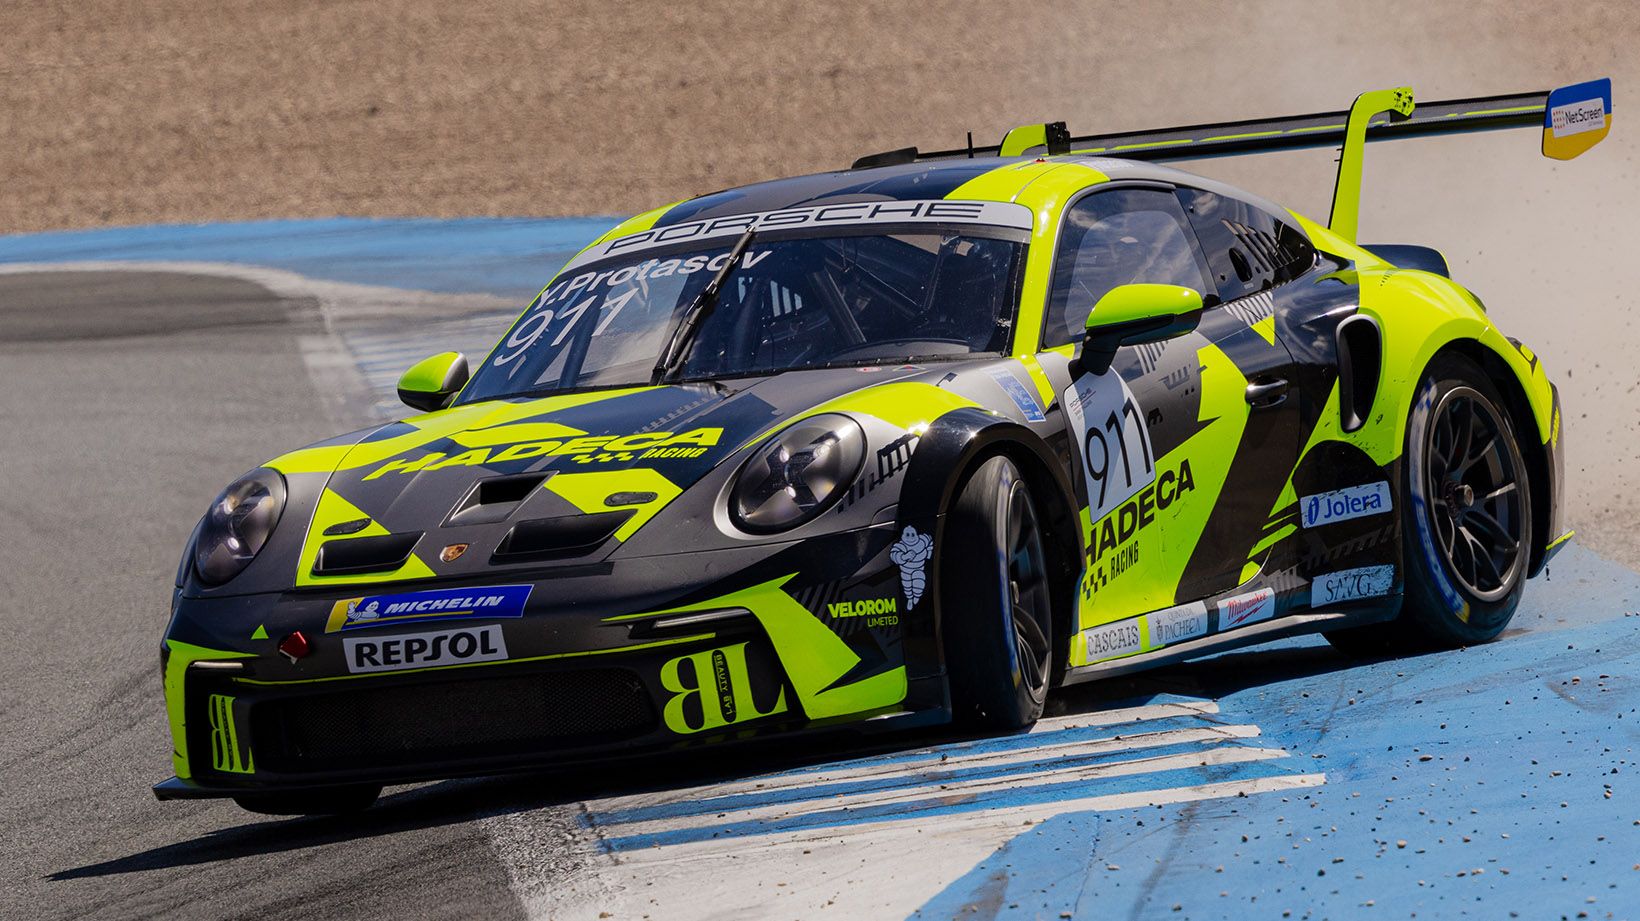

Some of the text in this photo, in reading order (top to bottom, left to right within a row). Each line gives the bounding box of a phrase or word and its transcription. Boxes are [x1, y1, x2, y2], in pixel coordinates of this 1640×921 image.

[1565, 107, 1603, 125] NetScreen
[603, 202, 985, 255] PORSCHE
[494, 287, 640, 367] 911
[361, 427, 724, 481] HADECA
[638, 447, 709, 460] RACING
[1085, 397, 1152, 510] 911
[1085, 458, 1196, 567] HADECA
[1324, 493, 1382, 519] Jolera
[1110, 540, 1139, 581] RACING
[384, 595, 505, 615] MICHELIN
[827, 598, 897, 619] VELOROM
[354, 631, 499, 668] REPSOL
[1088, 624, 1139, 656] CASCAIS
